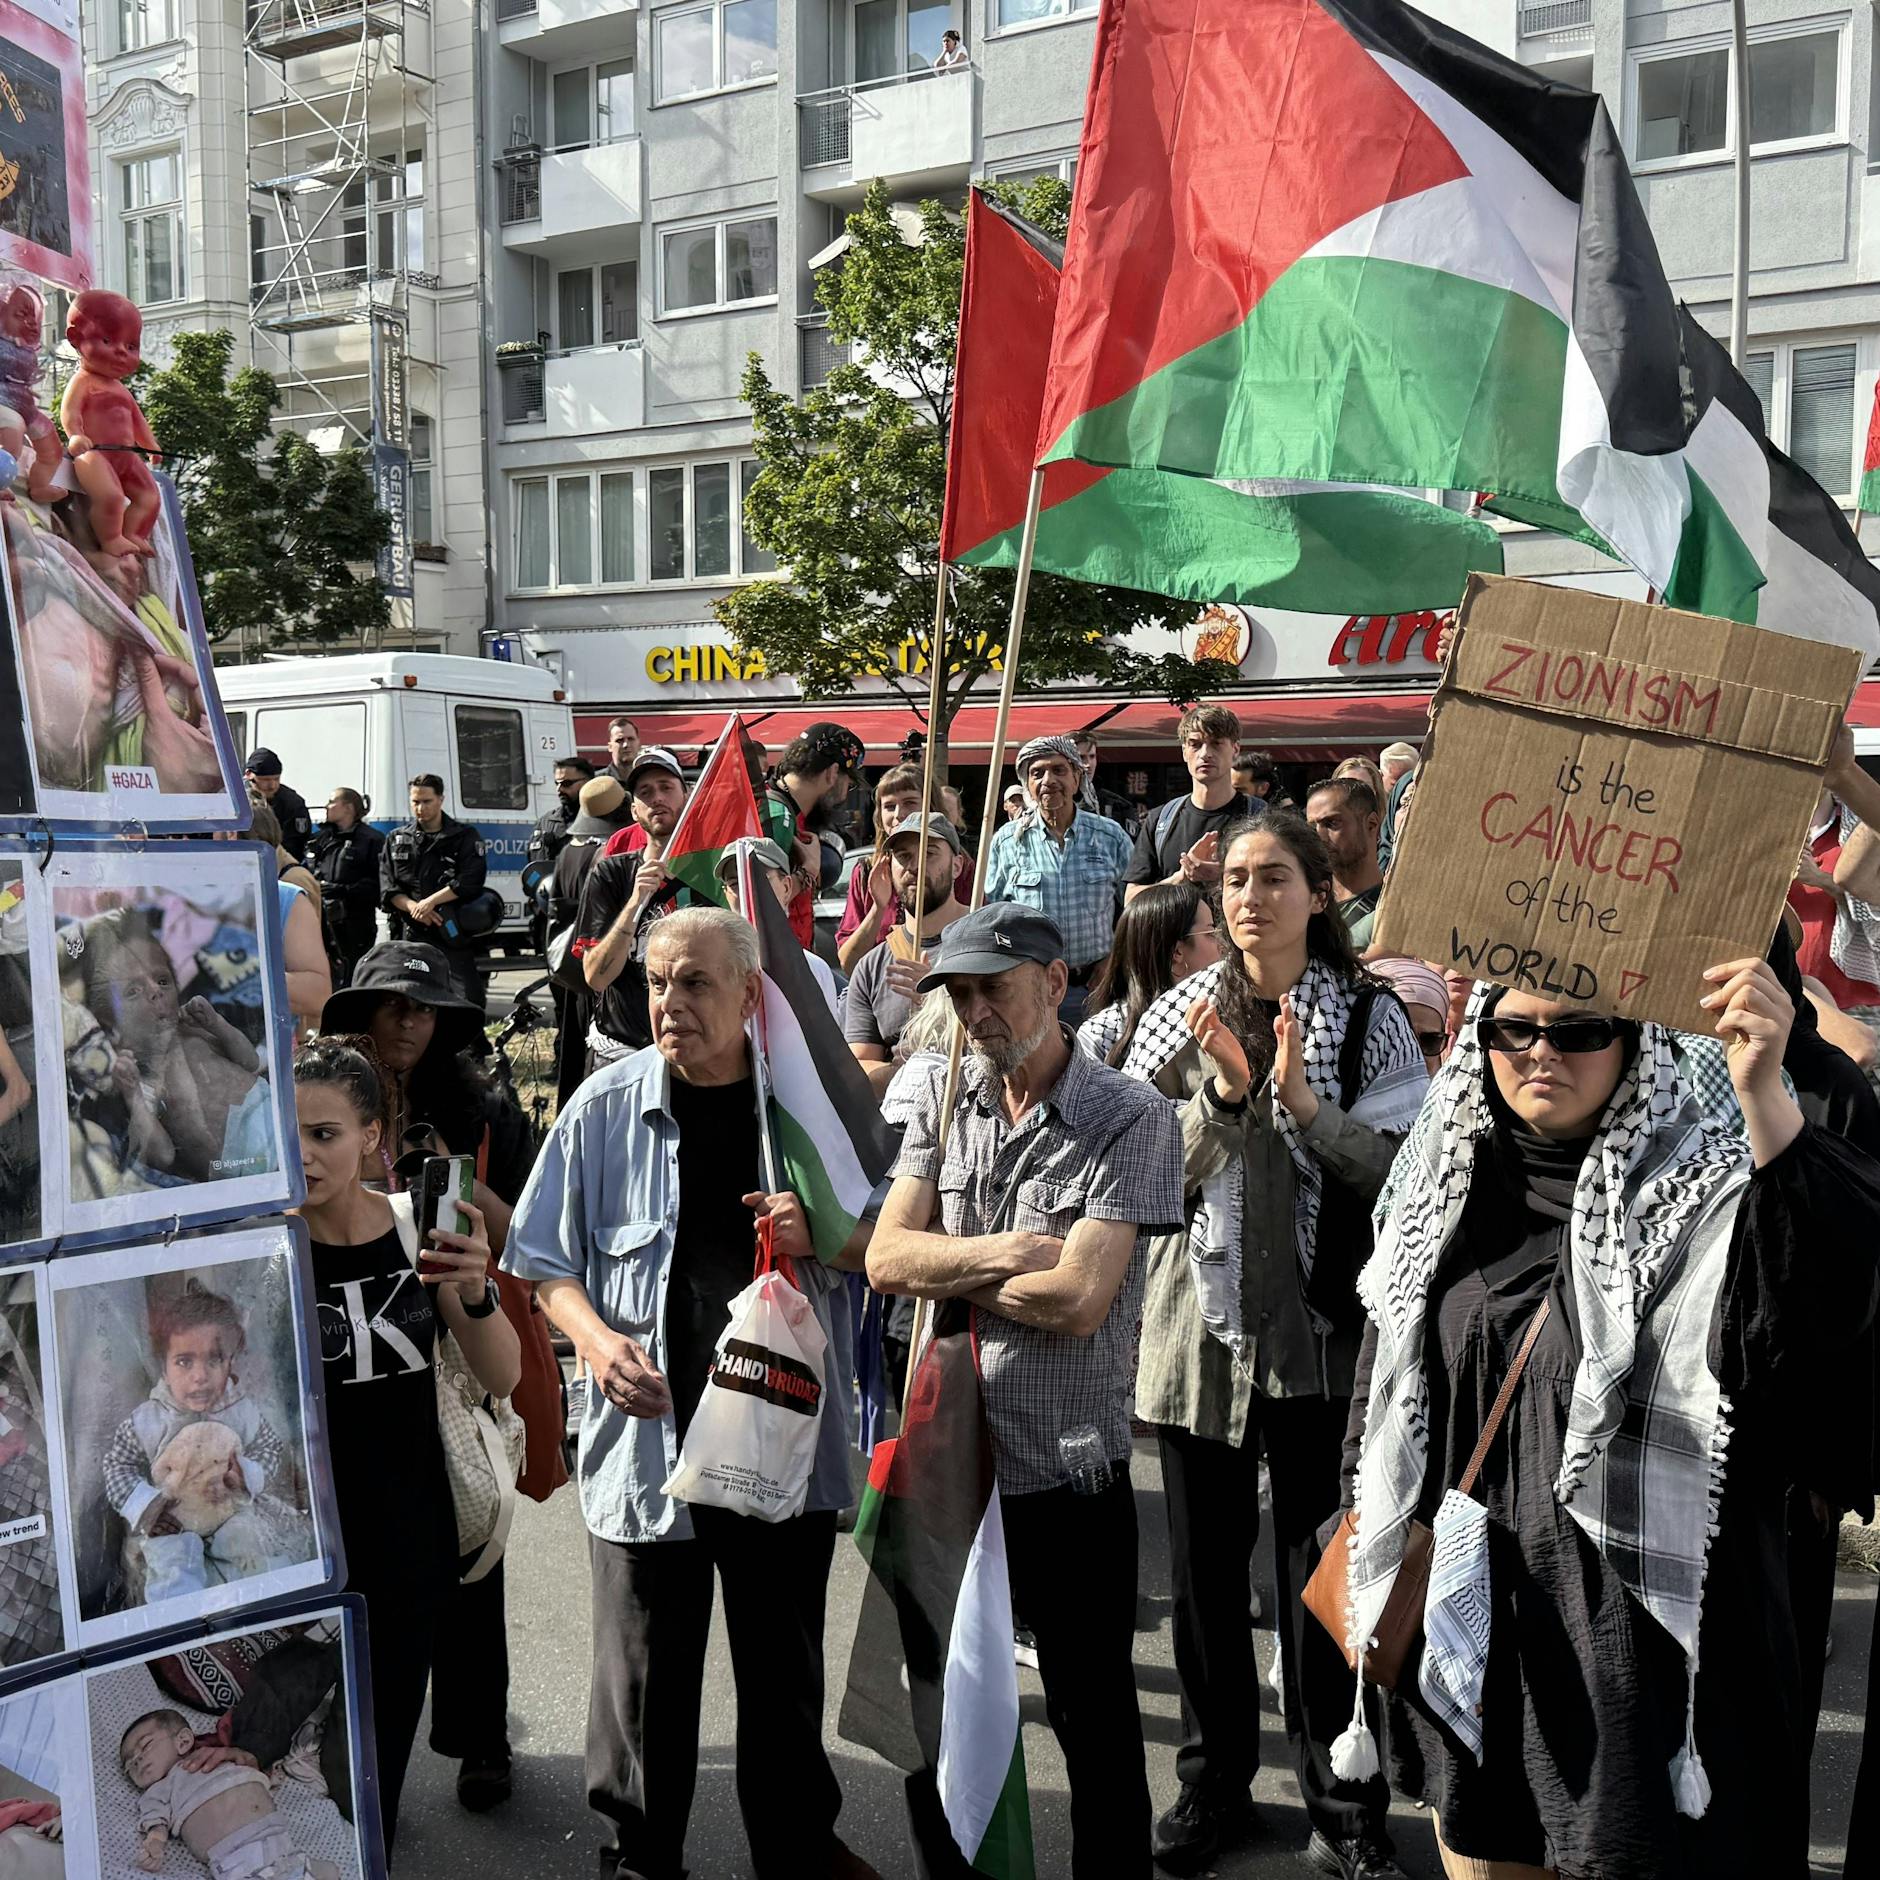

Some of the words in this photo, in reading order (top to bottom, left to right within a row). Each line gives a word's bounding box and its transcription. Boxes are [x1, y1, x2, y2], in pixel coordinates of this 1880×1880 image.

[390, 465, 405, 587] GERÜSTBAU
[645, 644, 767, 683] CHINA
[1484, 643, 1721, 733] ZIONISM
[541, 737, 556, 750] 25
[112, 772, 153, 789] #GAZA
[1557, 756, 1584, 794] is
[1600, 761, 1656, 814] the
[1481, 791, 1683, 893] CANCER
[1506, 876, 1551, 918] of
[1552, 882, 1622, 934] the
[1452, 926, 1598, 1000] WORLD
[13, 1521, 39, 1535] trend
